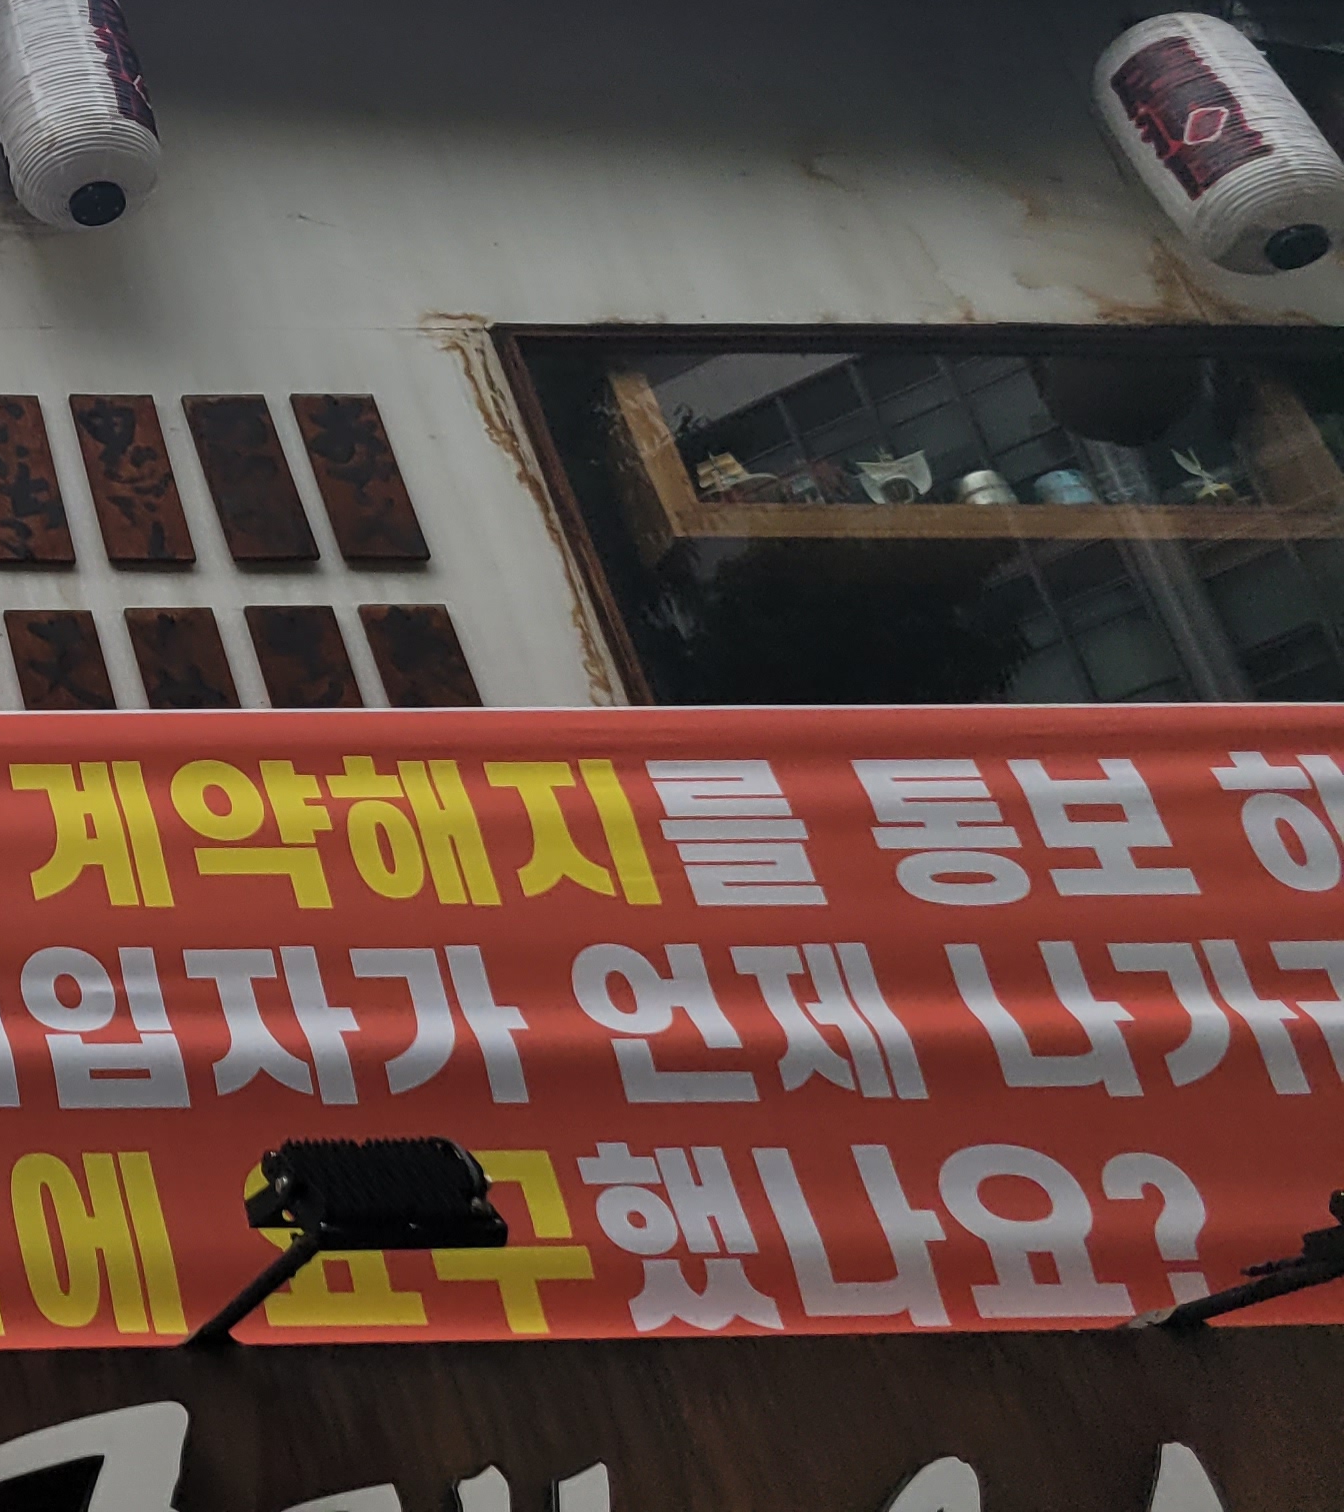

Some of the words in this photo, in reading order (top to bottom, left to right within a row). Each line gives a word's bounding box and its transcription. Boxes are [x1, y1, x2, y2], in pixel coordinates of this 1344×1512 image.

[9, 755, 829, 909] 계약해지를
[850, 757, 1202, 906] 통보
[571, 941, 930, 1103] 언제
